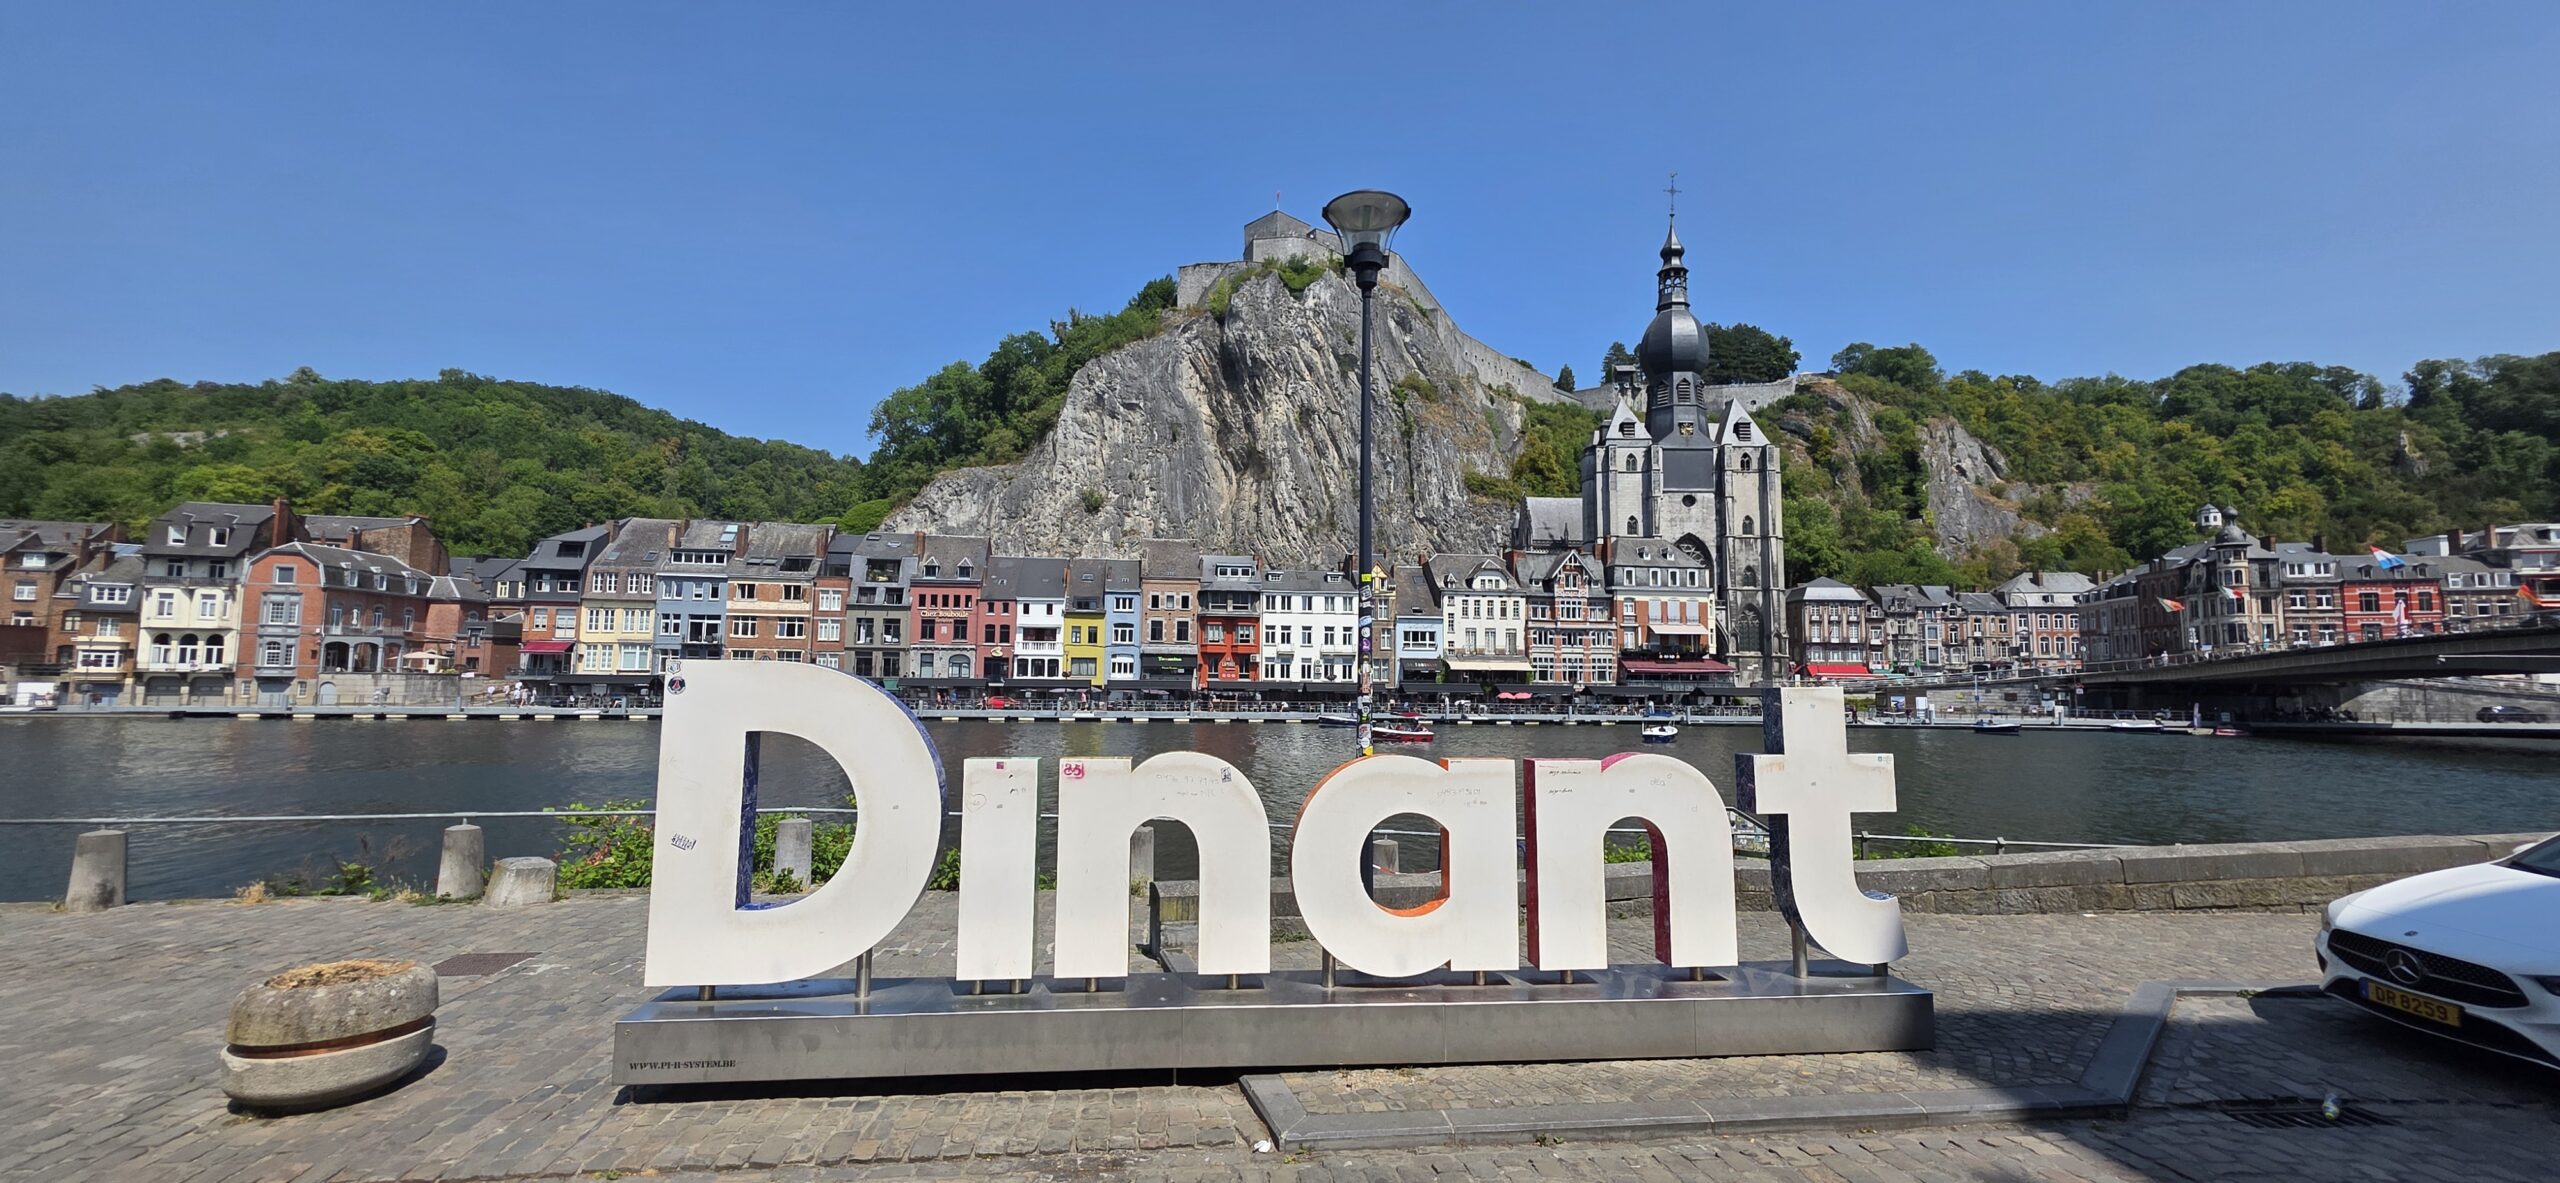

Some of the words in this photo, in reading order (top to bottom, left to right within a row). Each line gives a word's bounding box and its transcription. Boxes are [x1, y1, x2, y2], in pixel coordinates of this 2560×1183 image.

[644, 658, 1909, 988] Dinant
[2375, 986, 2396, 1006] DR
[2400, 995, 2448, 1021] 8259
